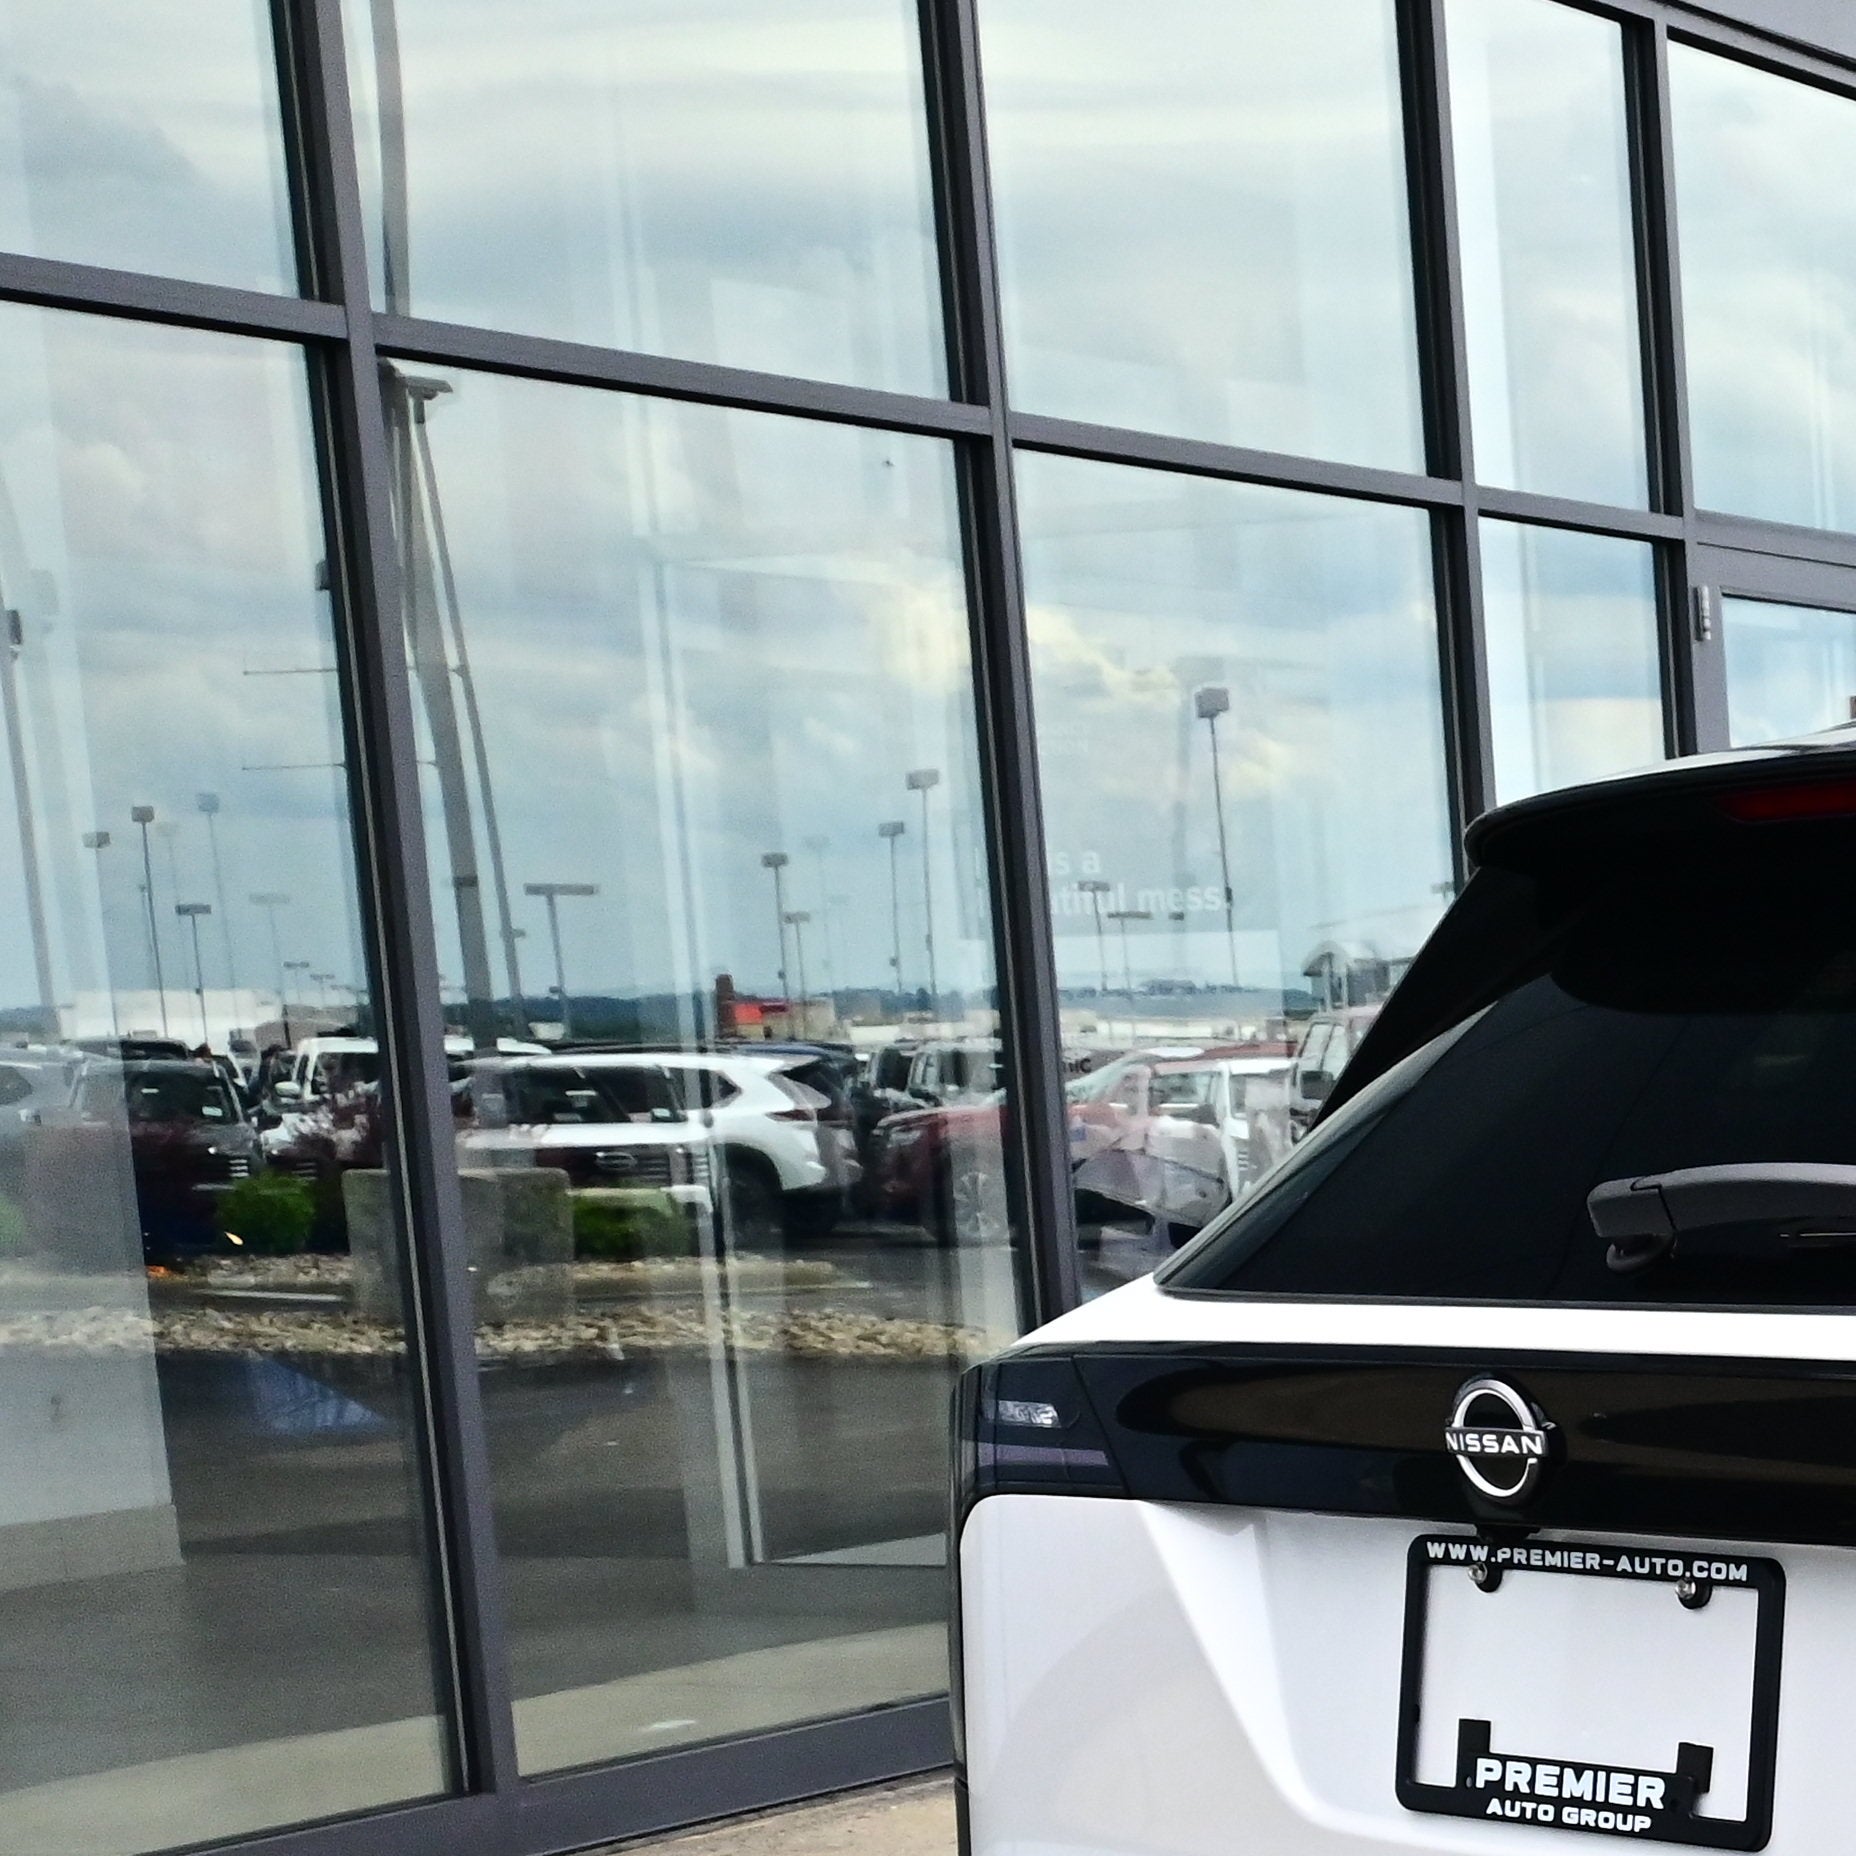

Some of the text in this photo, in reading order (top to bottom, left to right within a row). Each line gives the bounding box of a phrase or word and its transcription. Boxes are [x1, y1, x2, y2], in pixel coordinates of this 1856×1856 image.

[1081, 849, 1102, 875] a
[1445, 1431, 1543, 1455] NISSAN
[1426, 1540, 1749, 1582] WWW.PREMIER-AUTO.COM
[1475, 1757, 1666, 1810] PREMIER
[1486, 1798, 1652, 1833] AUTO GROUP
